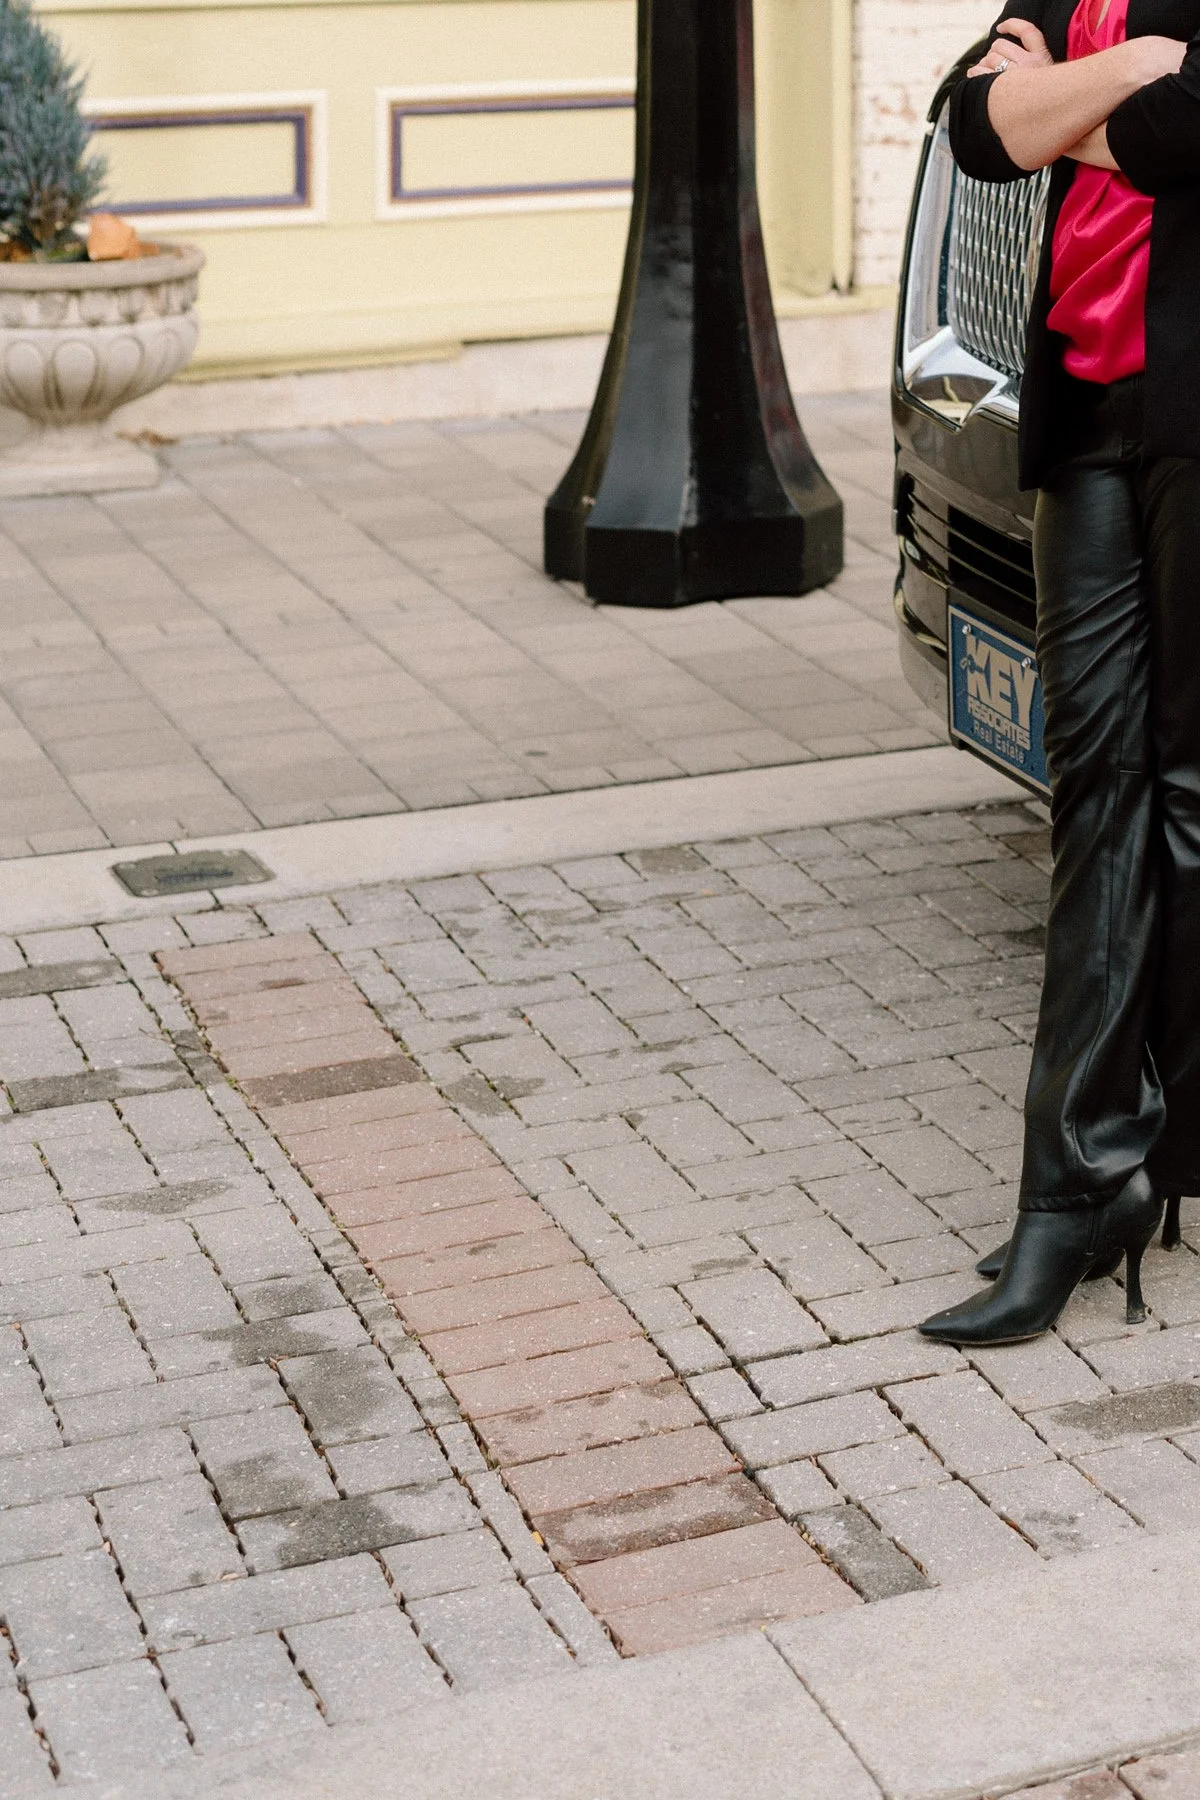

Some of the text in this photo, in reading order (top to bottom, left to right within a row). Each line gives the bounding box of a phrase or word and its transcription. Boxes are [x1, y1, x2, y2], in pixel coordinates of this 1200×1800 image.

[966, 633, 1037, 730] KEY
[972, 718, 1025, 764] Real Estate
